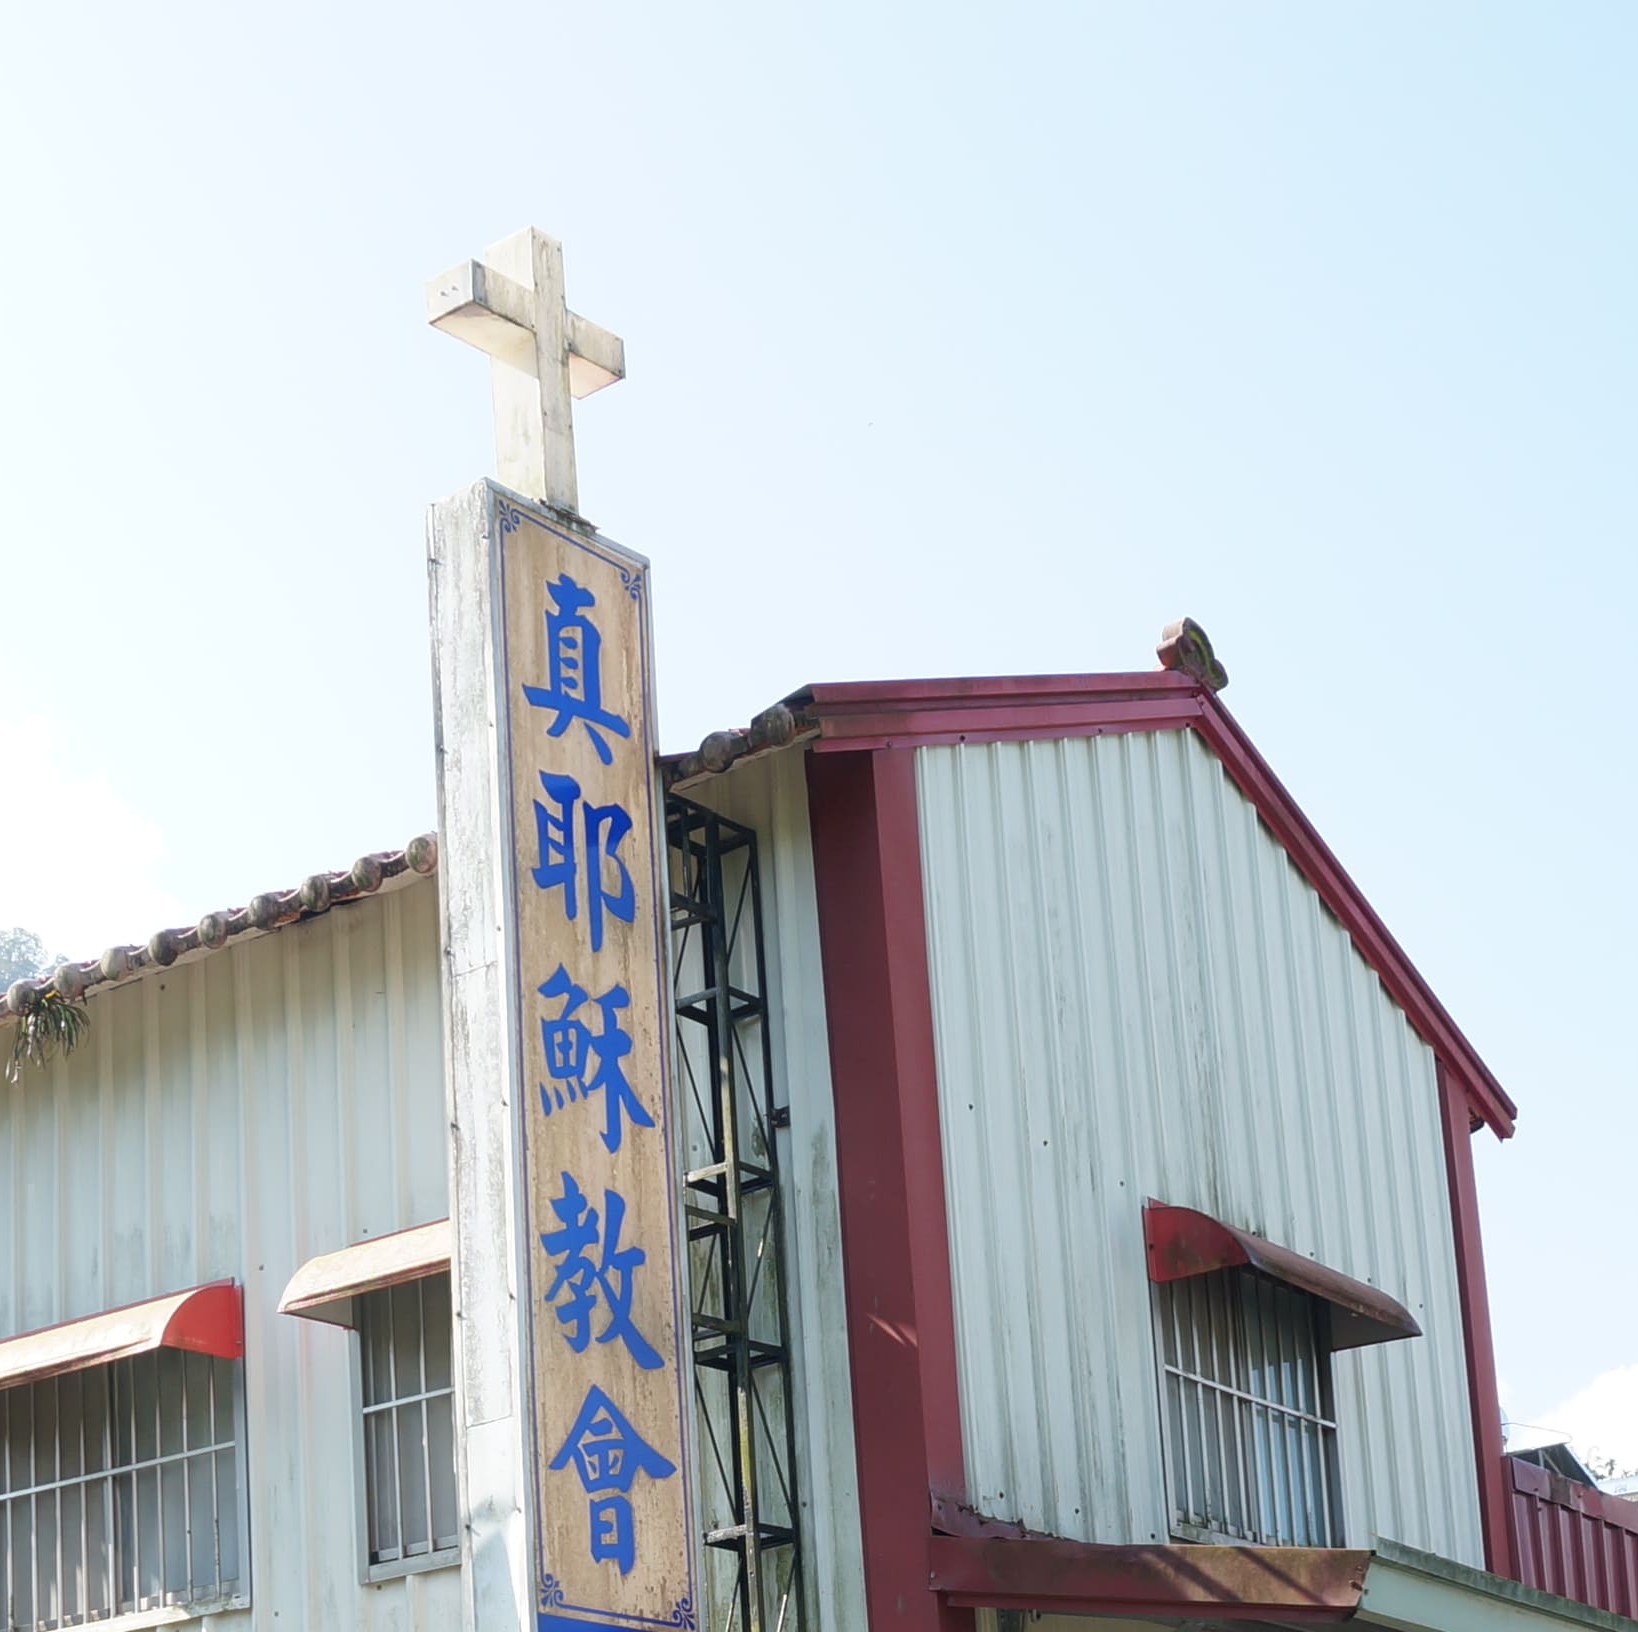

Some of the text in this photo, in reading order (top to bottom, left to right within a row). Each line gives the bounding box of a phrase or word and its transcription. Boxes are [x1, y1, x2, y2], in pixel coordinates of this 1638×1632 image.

[521, 573, 677, 1576] 真耶穌教會
